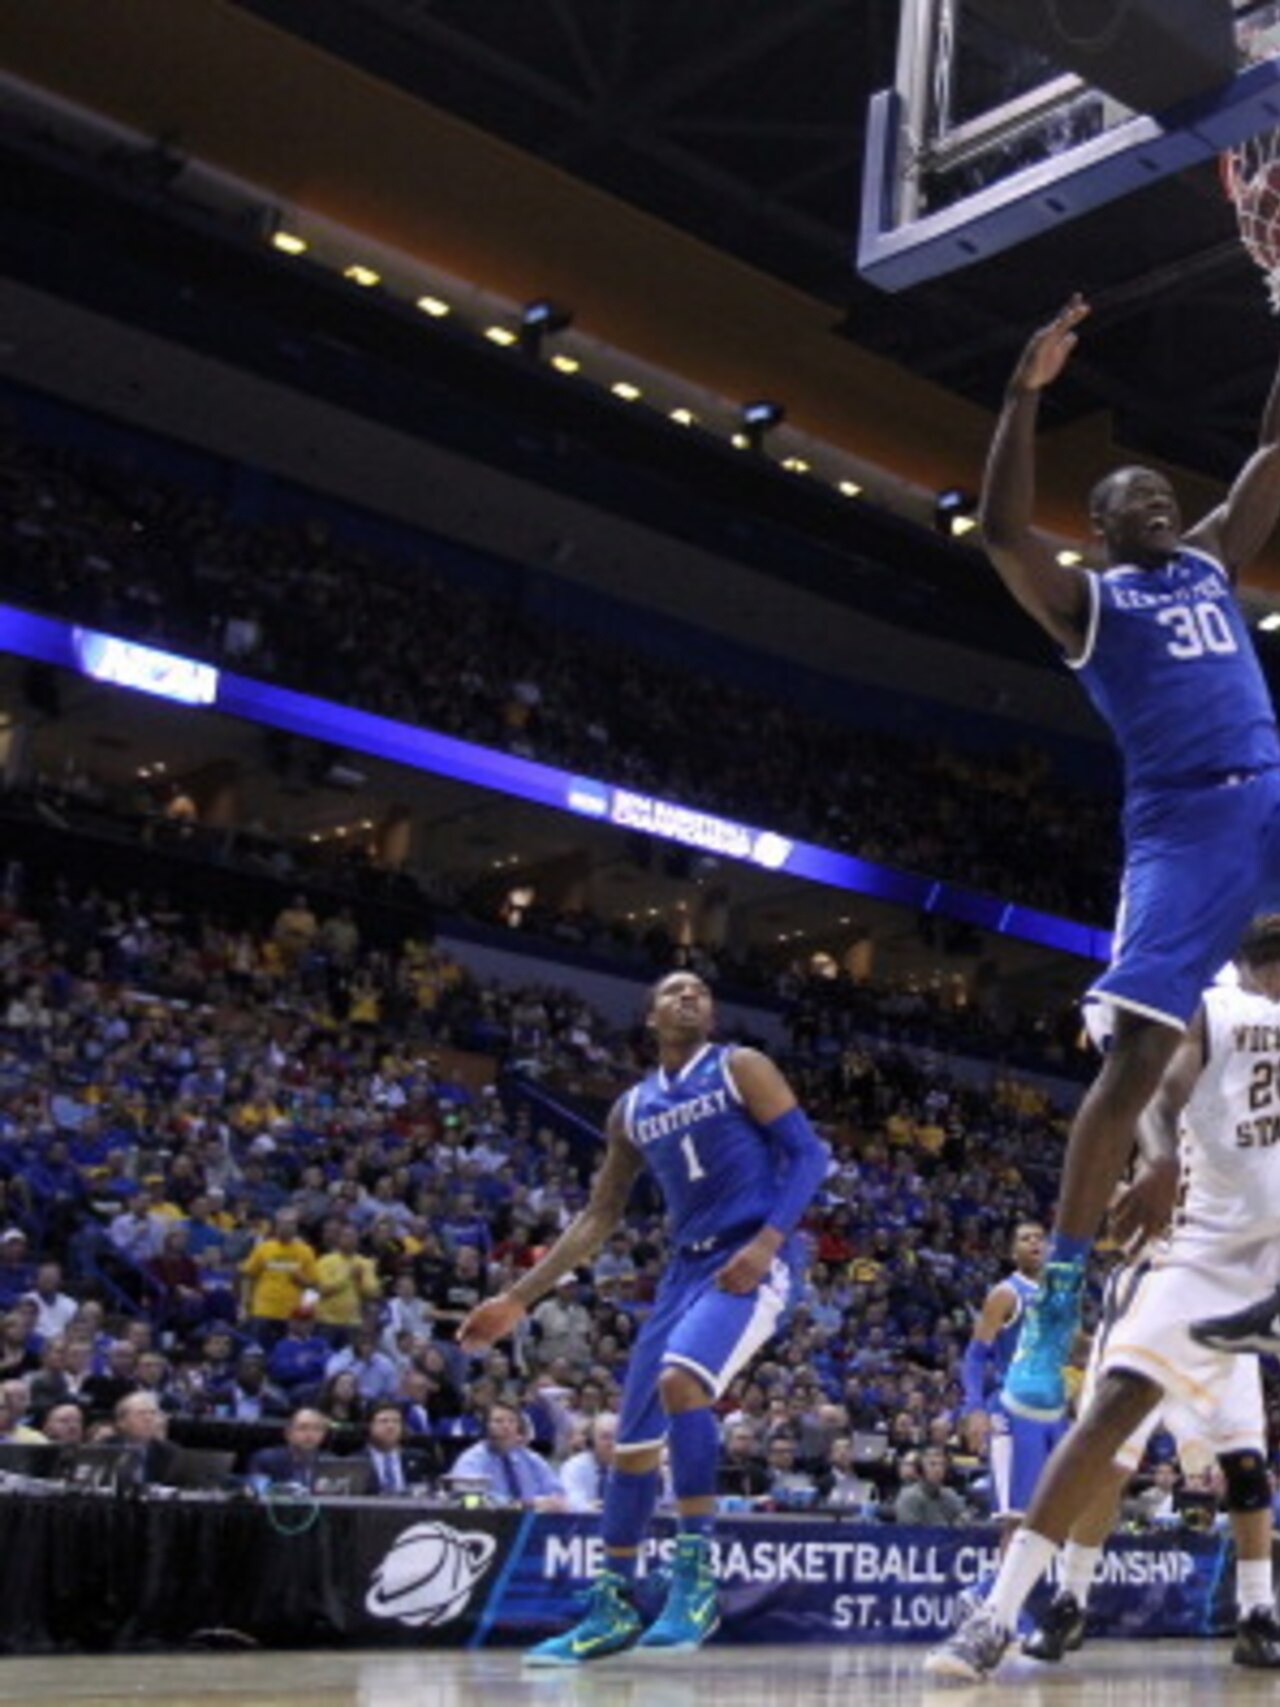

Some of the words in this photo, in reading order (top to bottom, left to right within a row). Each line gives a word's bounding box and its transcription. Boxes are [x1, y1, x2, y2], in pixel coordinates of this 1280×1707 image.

[1156, 602, 1238, 661] 30
[637, 1089, 726, 1144] KENTUCKY
[680, 1132, 705, 1182] 1
[543, 1536, 678, 1579] ME'S
[955, 1546, 1196, 1585] CHONSHIP
[832, 1594, 882, 1629] ST.
[890, 1596, 952, 1629] LOU
